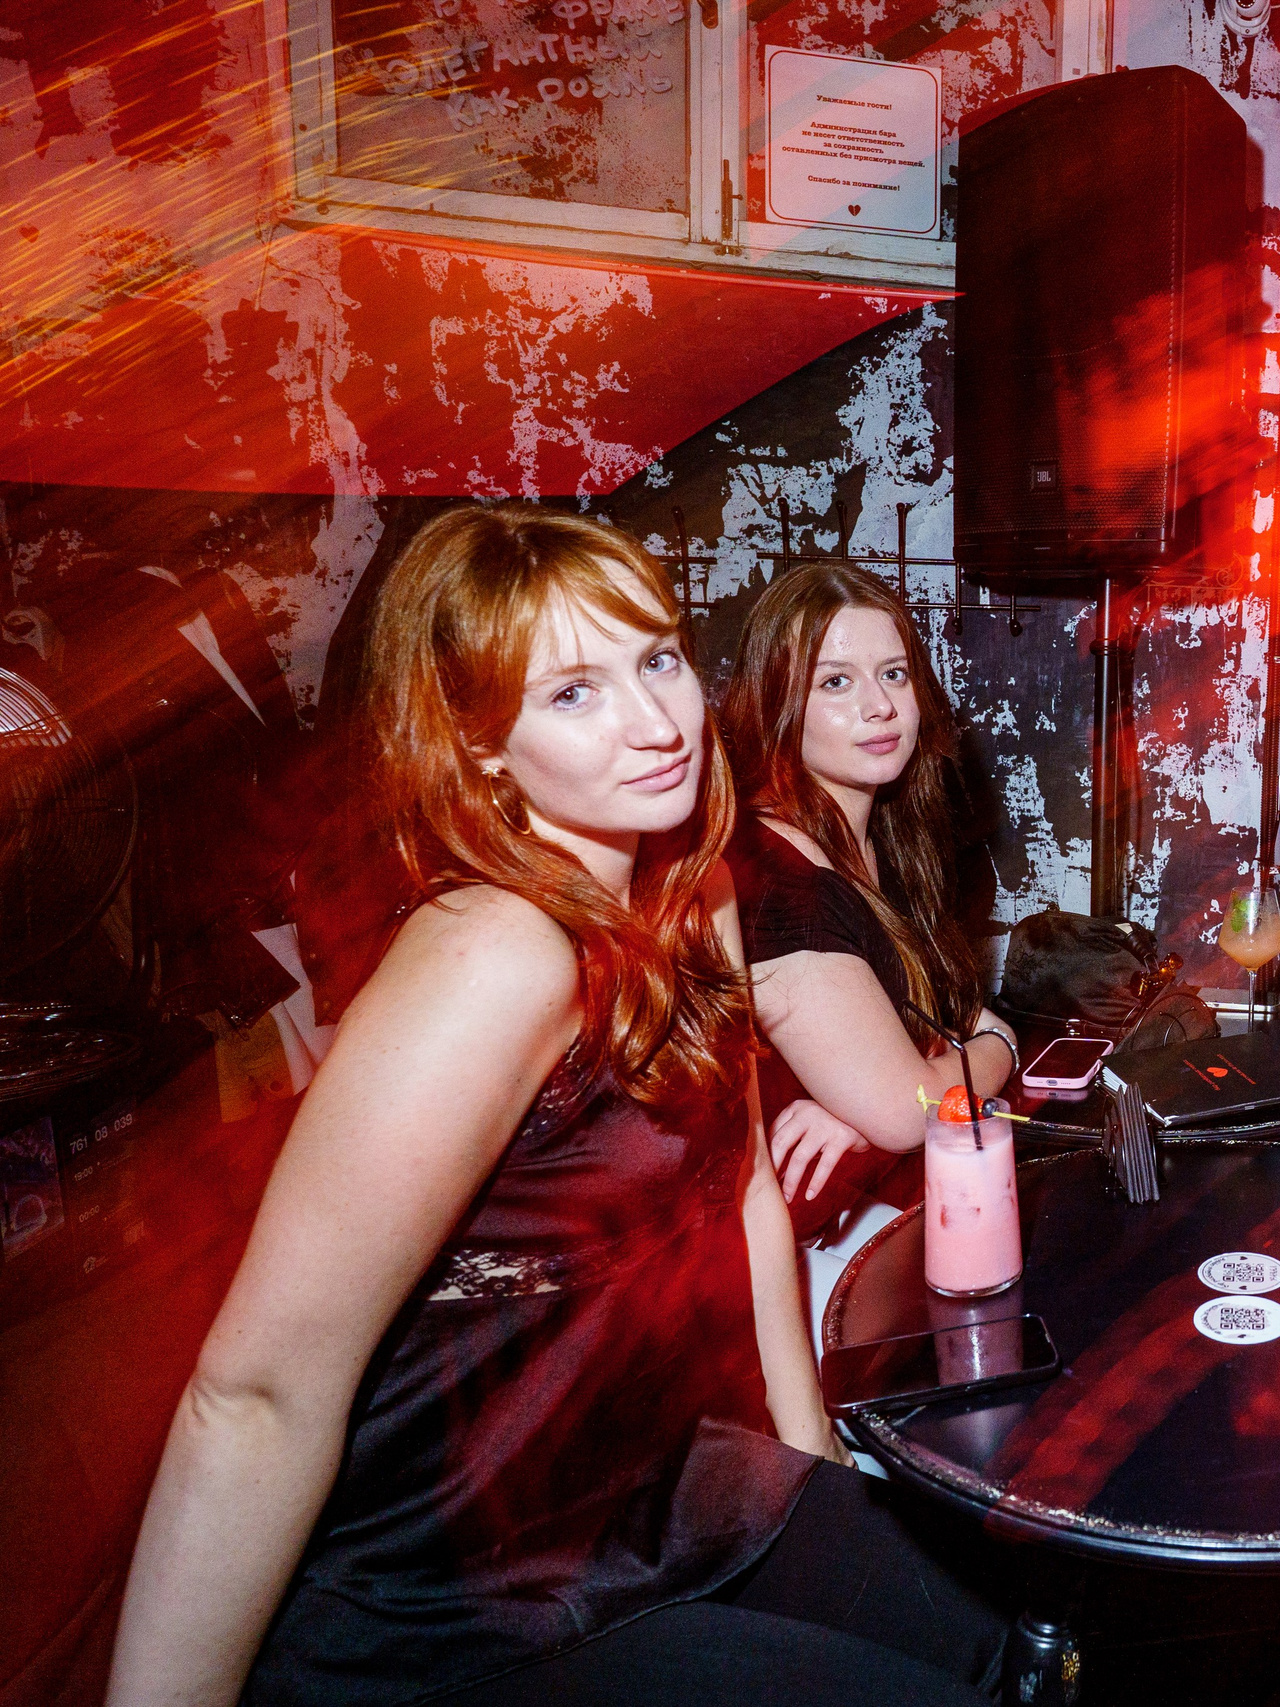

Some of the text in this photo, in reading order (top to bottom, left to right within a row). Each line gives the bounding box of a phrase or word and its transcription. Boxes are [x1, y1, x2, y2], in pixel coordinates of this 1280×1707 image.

[385, 29, 664, 95] ЭЛЕГАНТНЫЙ
[448, 76, 674, 132] КАК РОЯЛЬ
[816, 94, 893, 111] Уважаемые гости!
[801, 129, 905, 148] не несет ответственность
[810, 121, 897, 138] Администрация бара
[782, 145, 926, 168] оставленных без присмотра вещей.
[833, 143, 884, 154] сохранность
[807, 175, 841, 185] Спасибо
[852, 181, 900, 192] понимание!
[1037, 471, 1051, 482] JBL
[69, 1113, 133, 1154] 761 08 039
